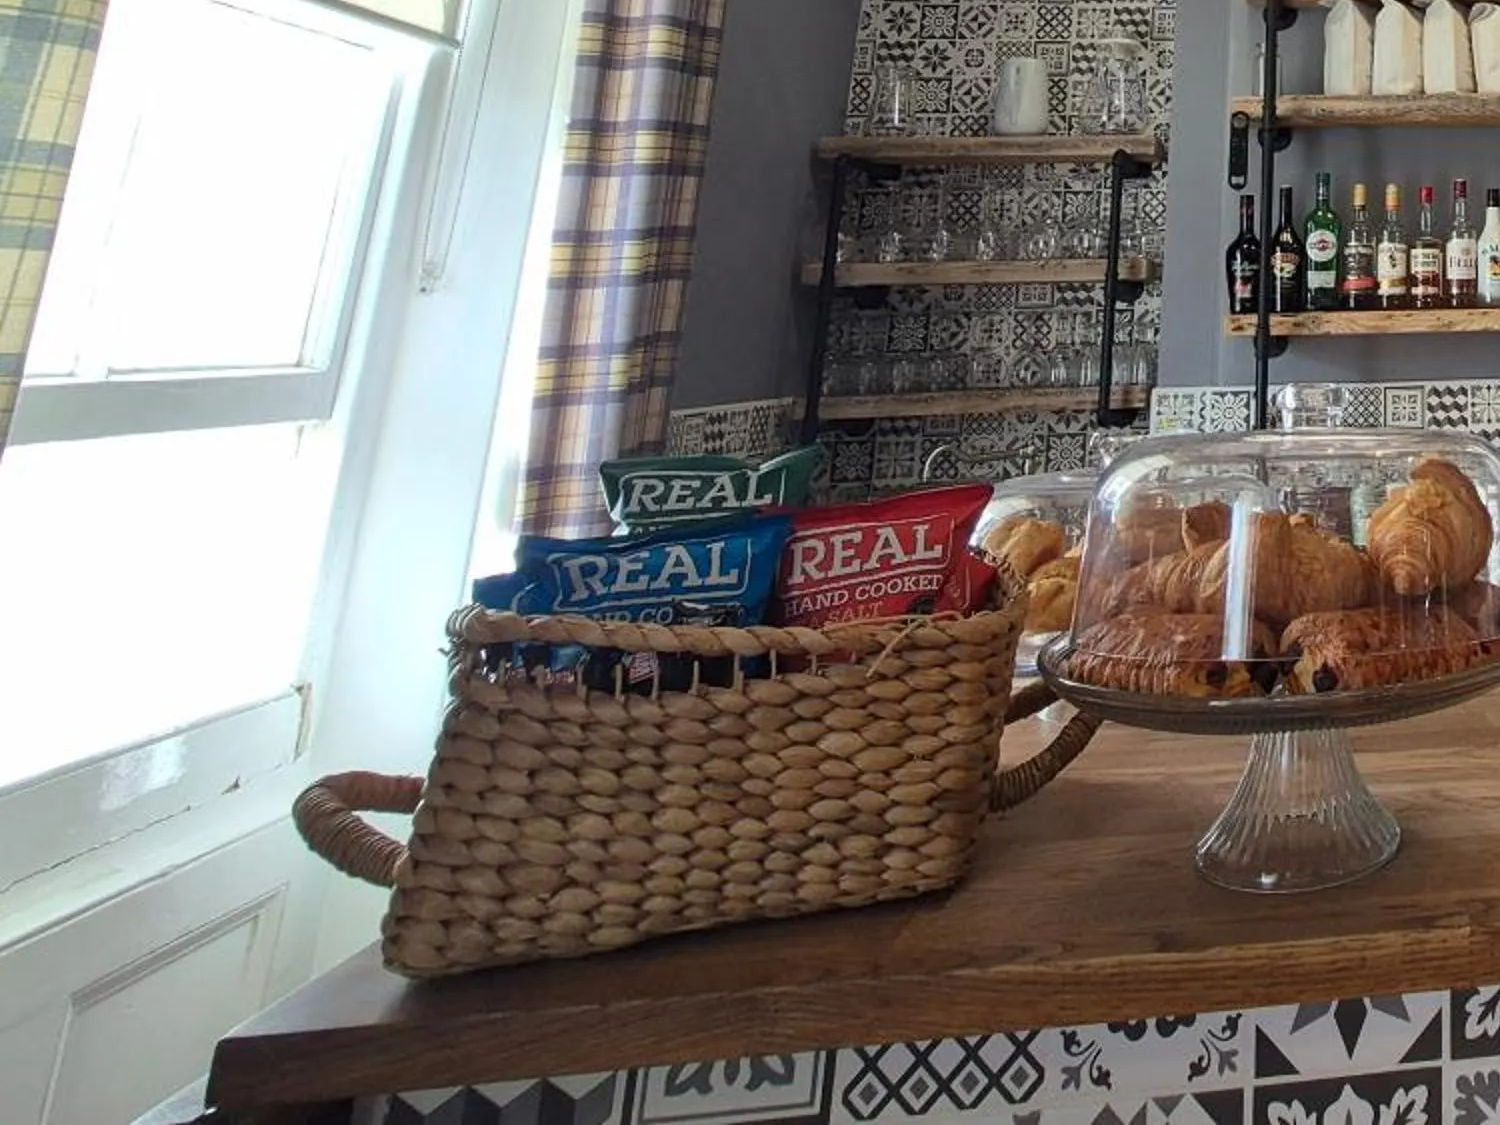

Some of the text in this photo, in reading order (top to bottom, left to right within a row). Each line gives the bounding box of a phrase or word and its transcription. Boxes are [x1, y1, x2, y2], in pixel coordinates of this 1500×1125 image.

[627, 472, 773, 514] REAL
[562, 540, 739, 602] REAL
[787, 525, 943, 586] REAL
[784, 589, 849, 618] HAND
